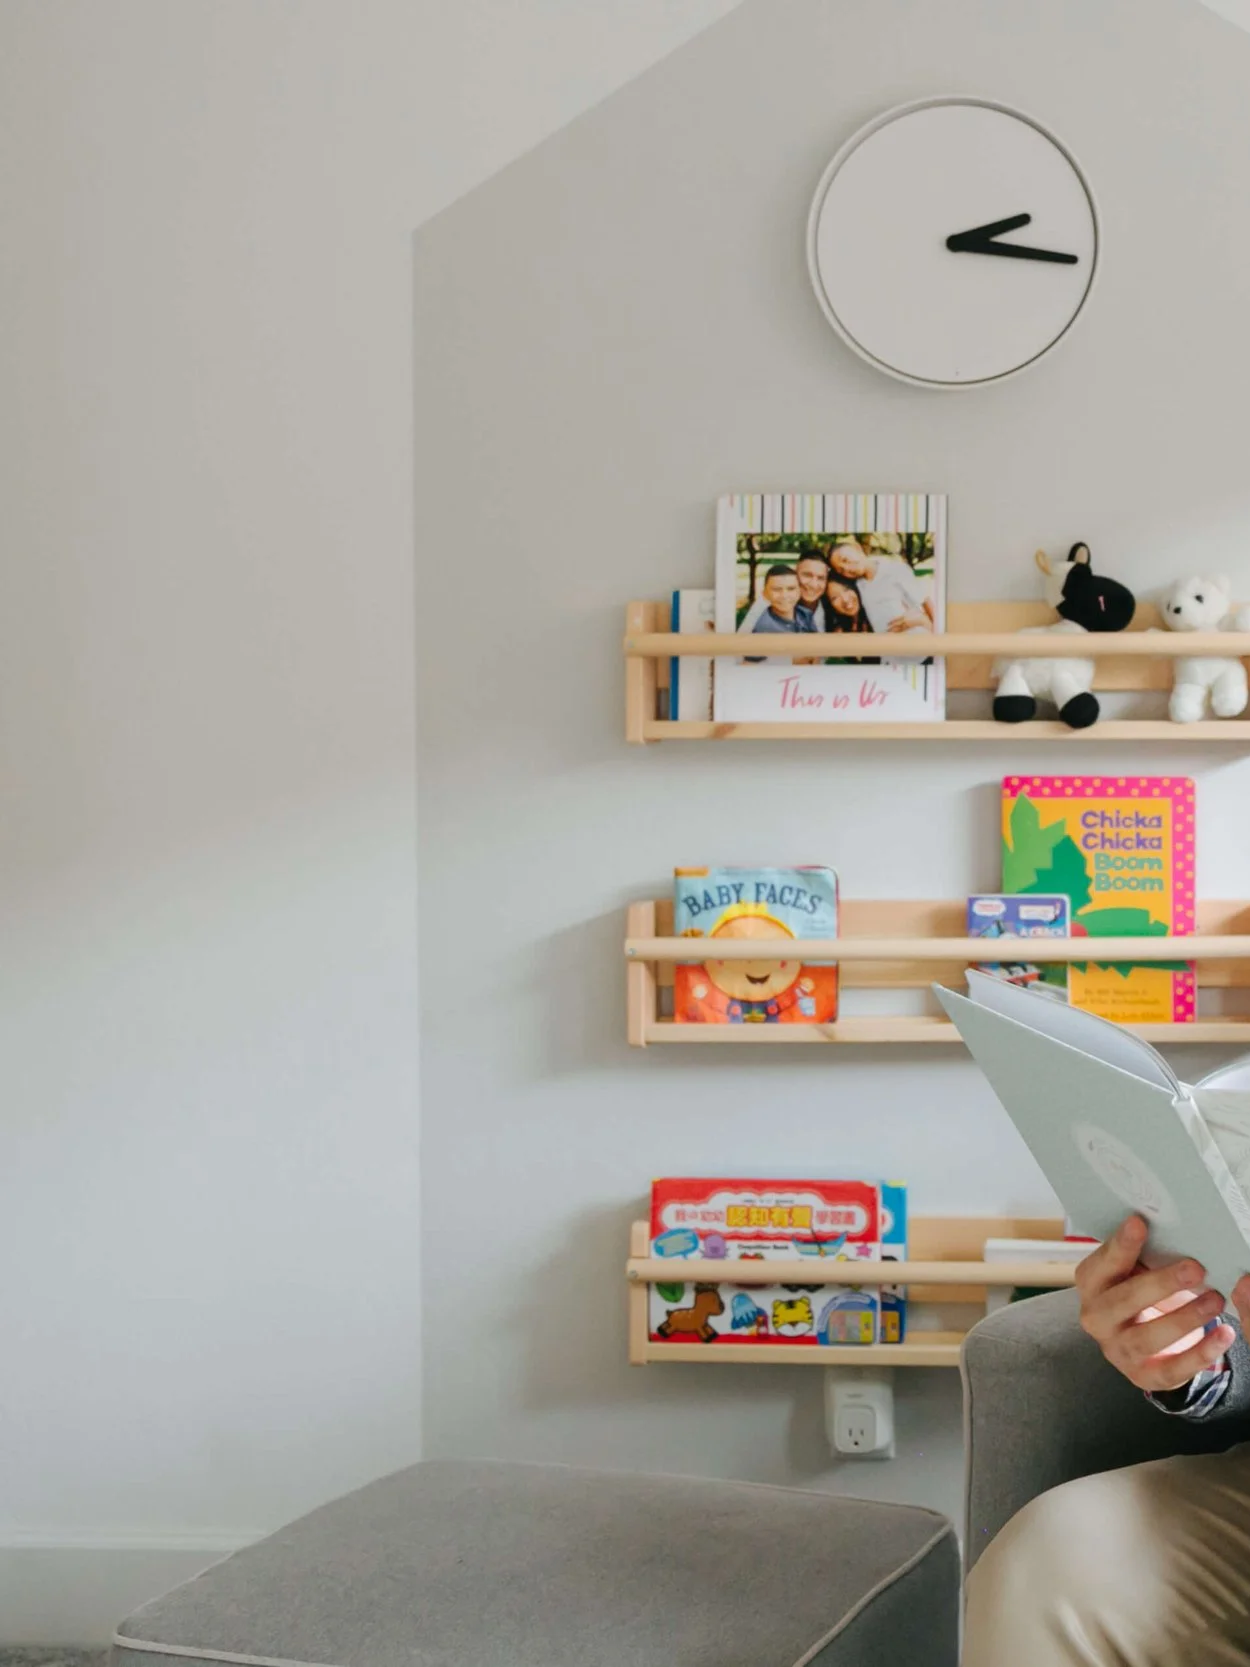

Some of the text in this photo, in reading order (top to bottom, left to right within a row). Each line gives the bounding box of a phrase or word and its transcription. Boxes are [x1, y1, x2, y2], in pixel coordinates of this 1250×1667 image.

[778, 674, 891, 710] This is Us
[1080, 809, 1162, 830] Chicka
[1081, 831, 1162, 850] Chicka
[1094, 852, 1163, 872] Boom
[1094, 872, 1164, 892] Boom
[682, 881, 823, 918] BABY FACES
